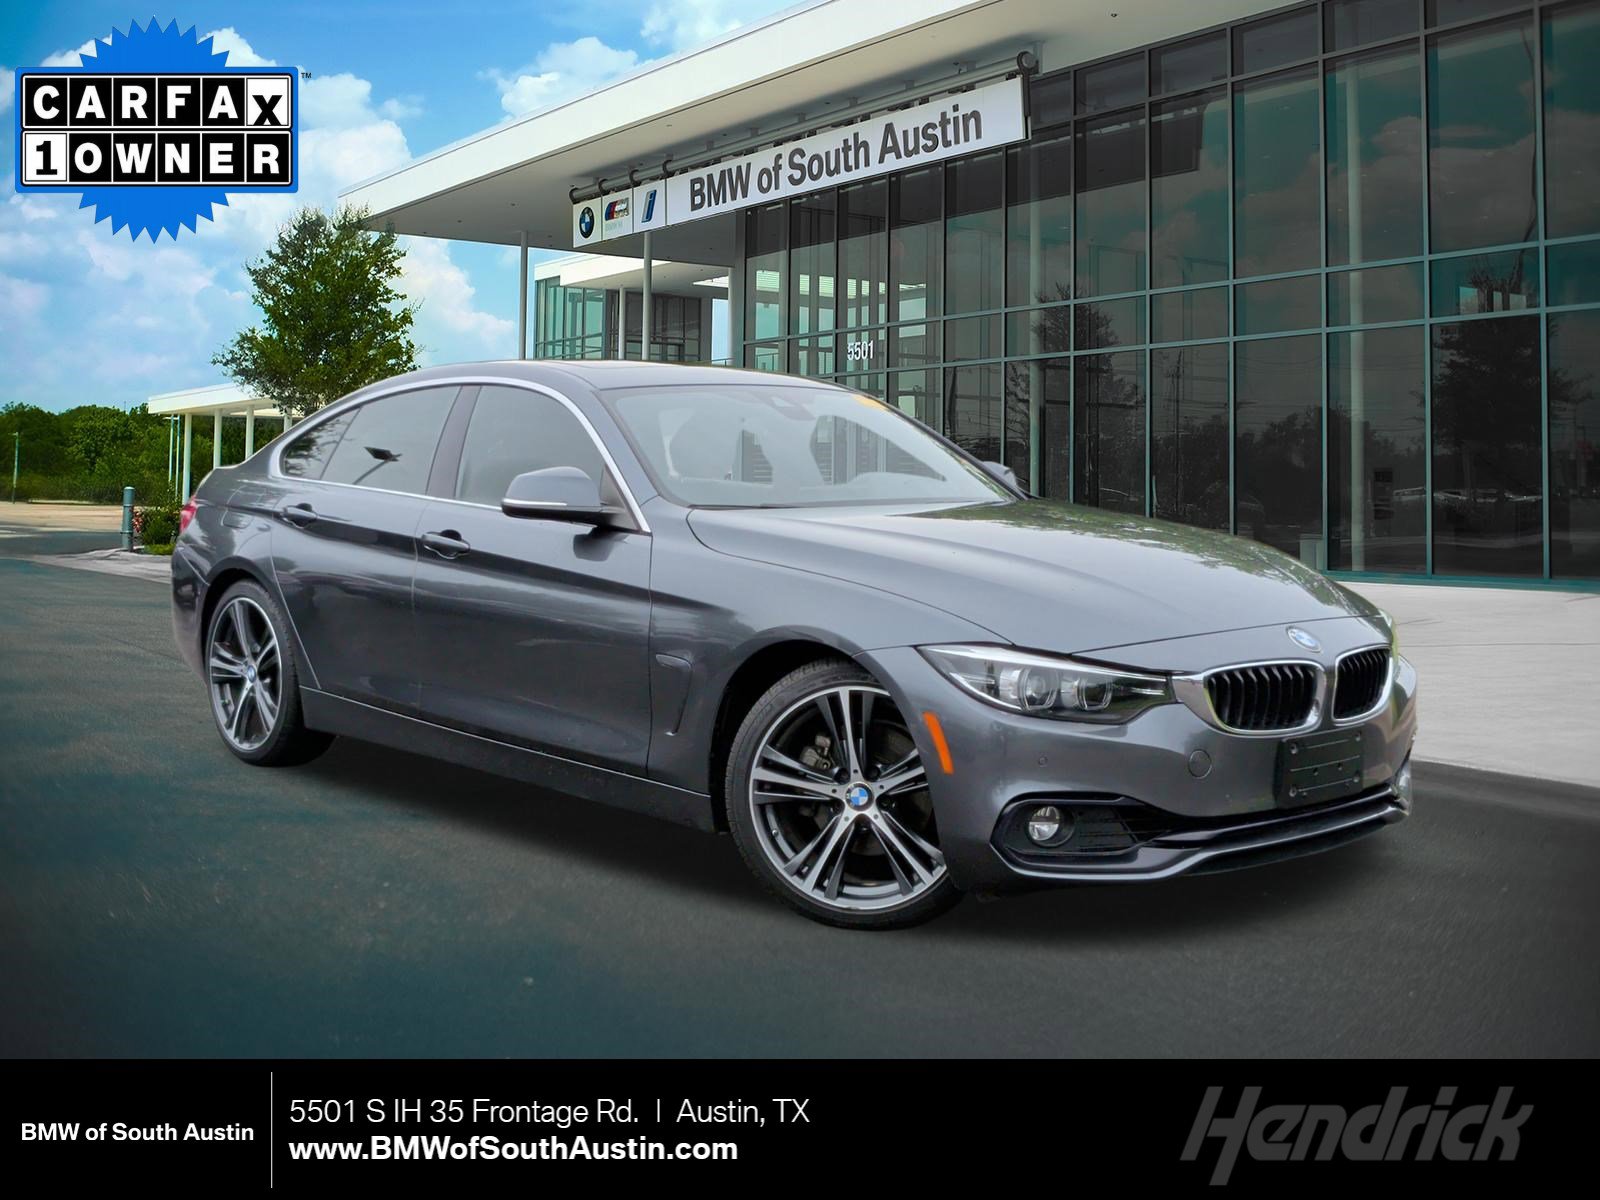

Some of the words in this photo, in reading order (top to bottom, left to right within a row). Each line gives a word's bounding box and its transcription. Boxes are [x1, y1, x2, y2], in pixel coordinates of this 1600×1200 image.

[690, 162, 752, 212] BMW
[757, 153, 783, 195] of
[787, 132, 871, 187] South
[878, 103, 982, 165] Austin
[847, 340, 874, 361] 5501
